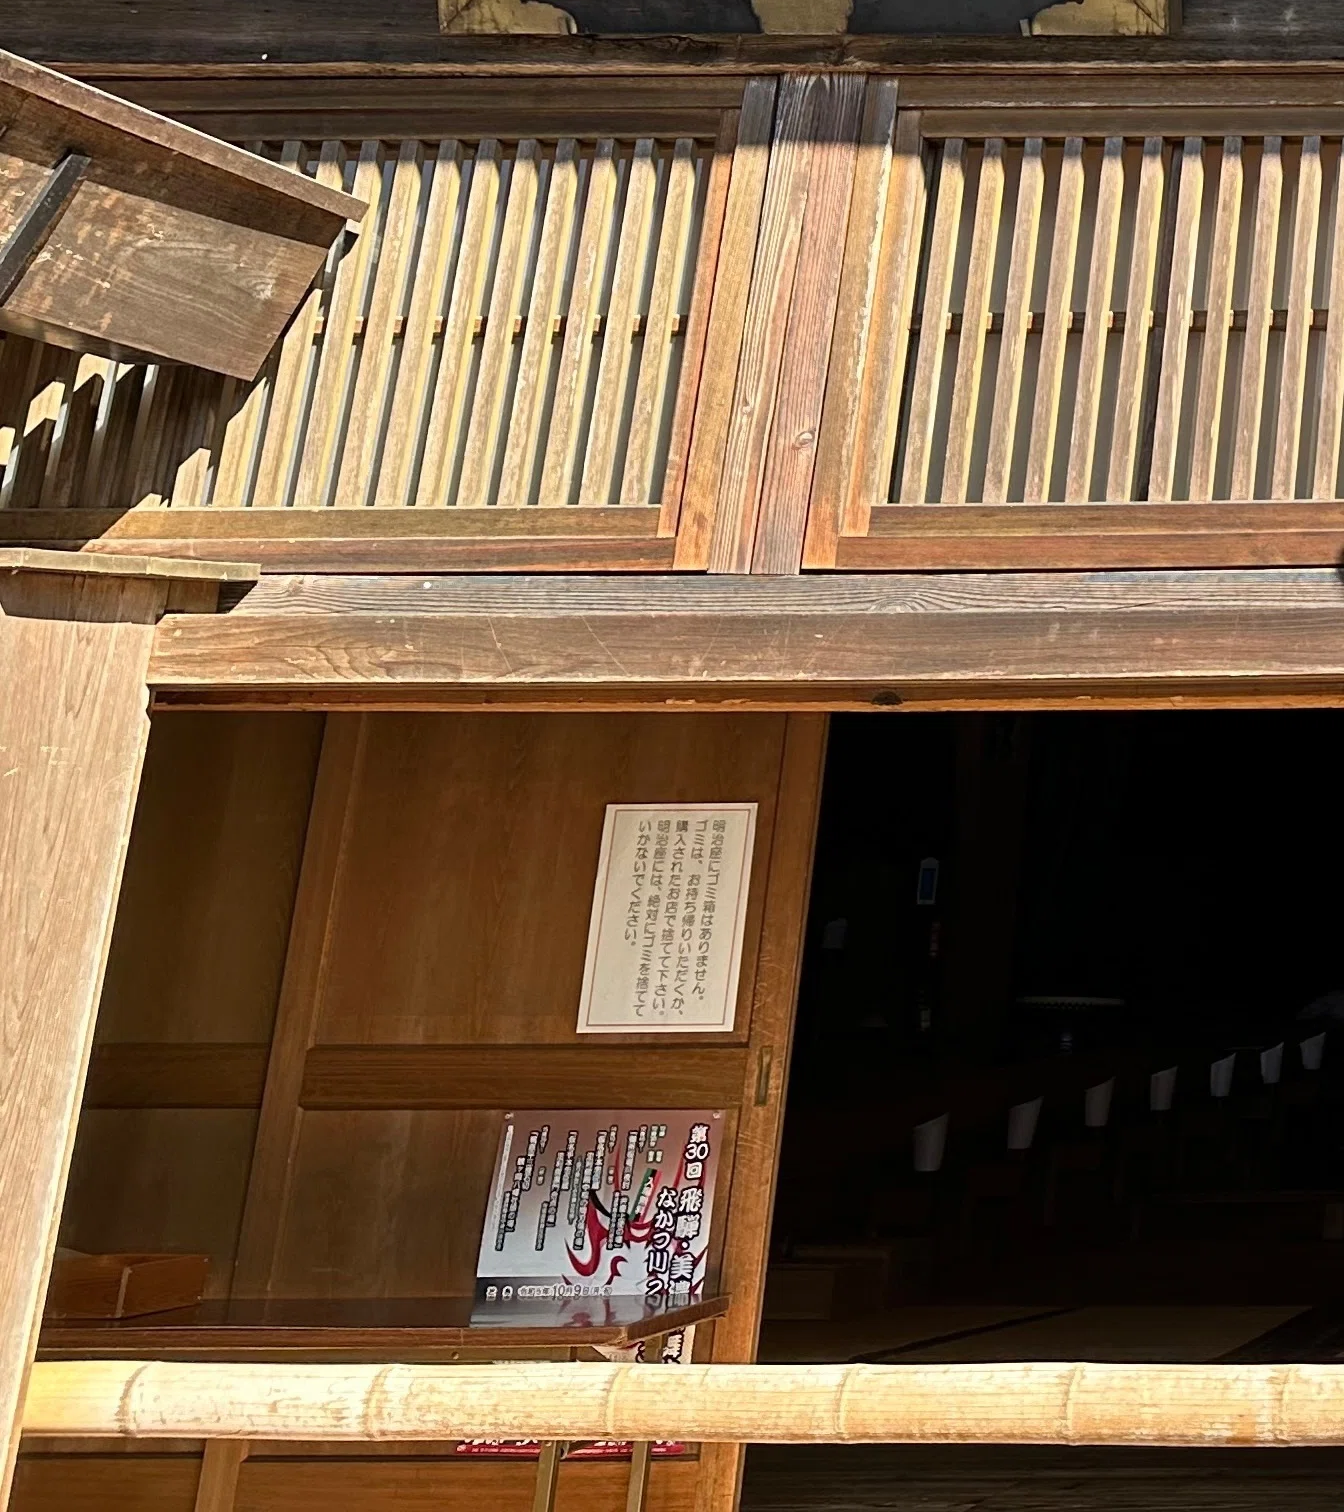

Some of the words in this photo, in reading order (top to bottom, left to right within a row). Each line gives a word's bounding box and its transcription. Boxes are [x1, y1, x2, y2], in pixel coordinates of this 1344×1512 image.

[625, 820, 651, 946] いかないでください。
[685, 1124, 709, 1179] 第30回
